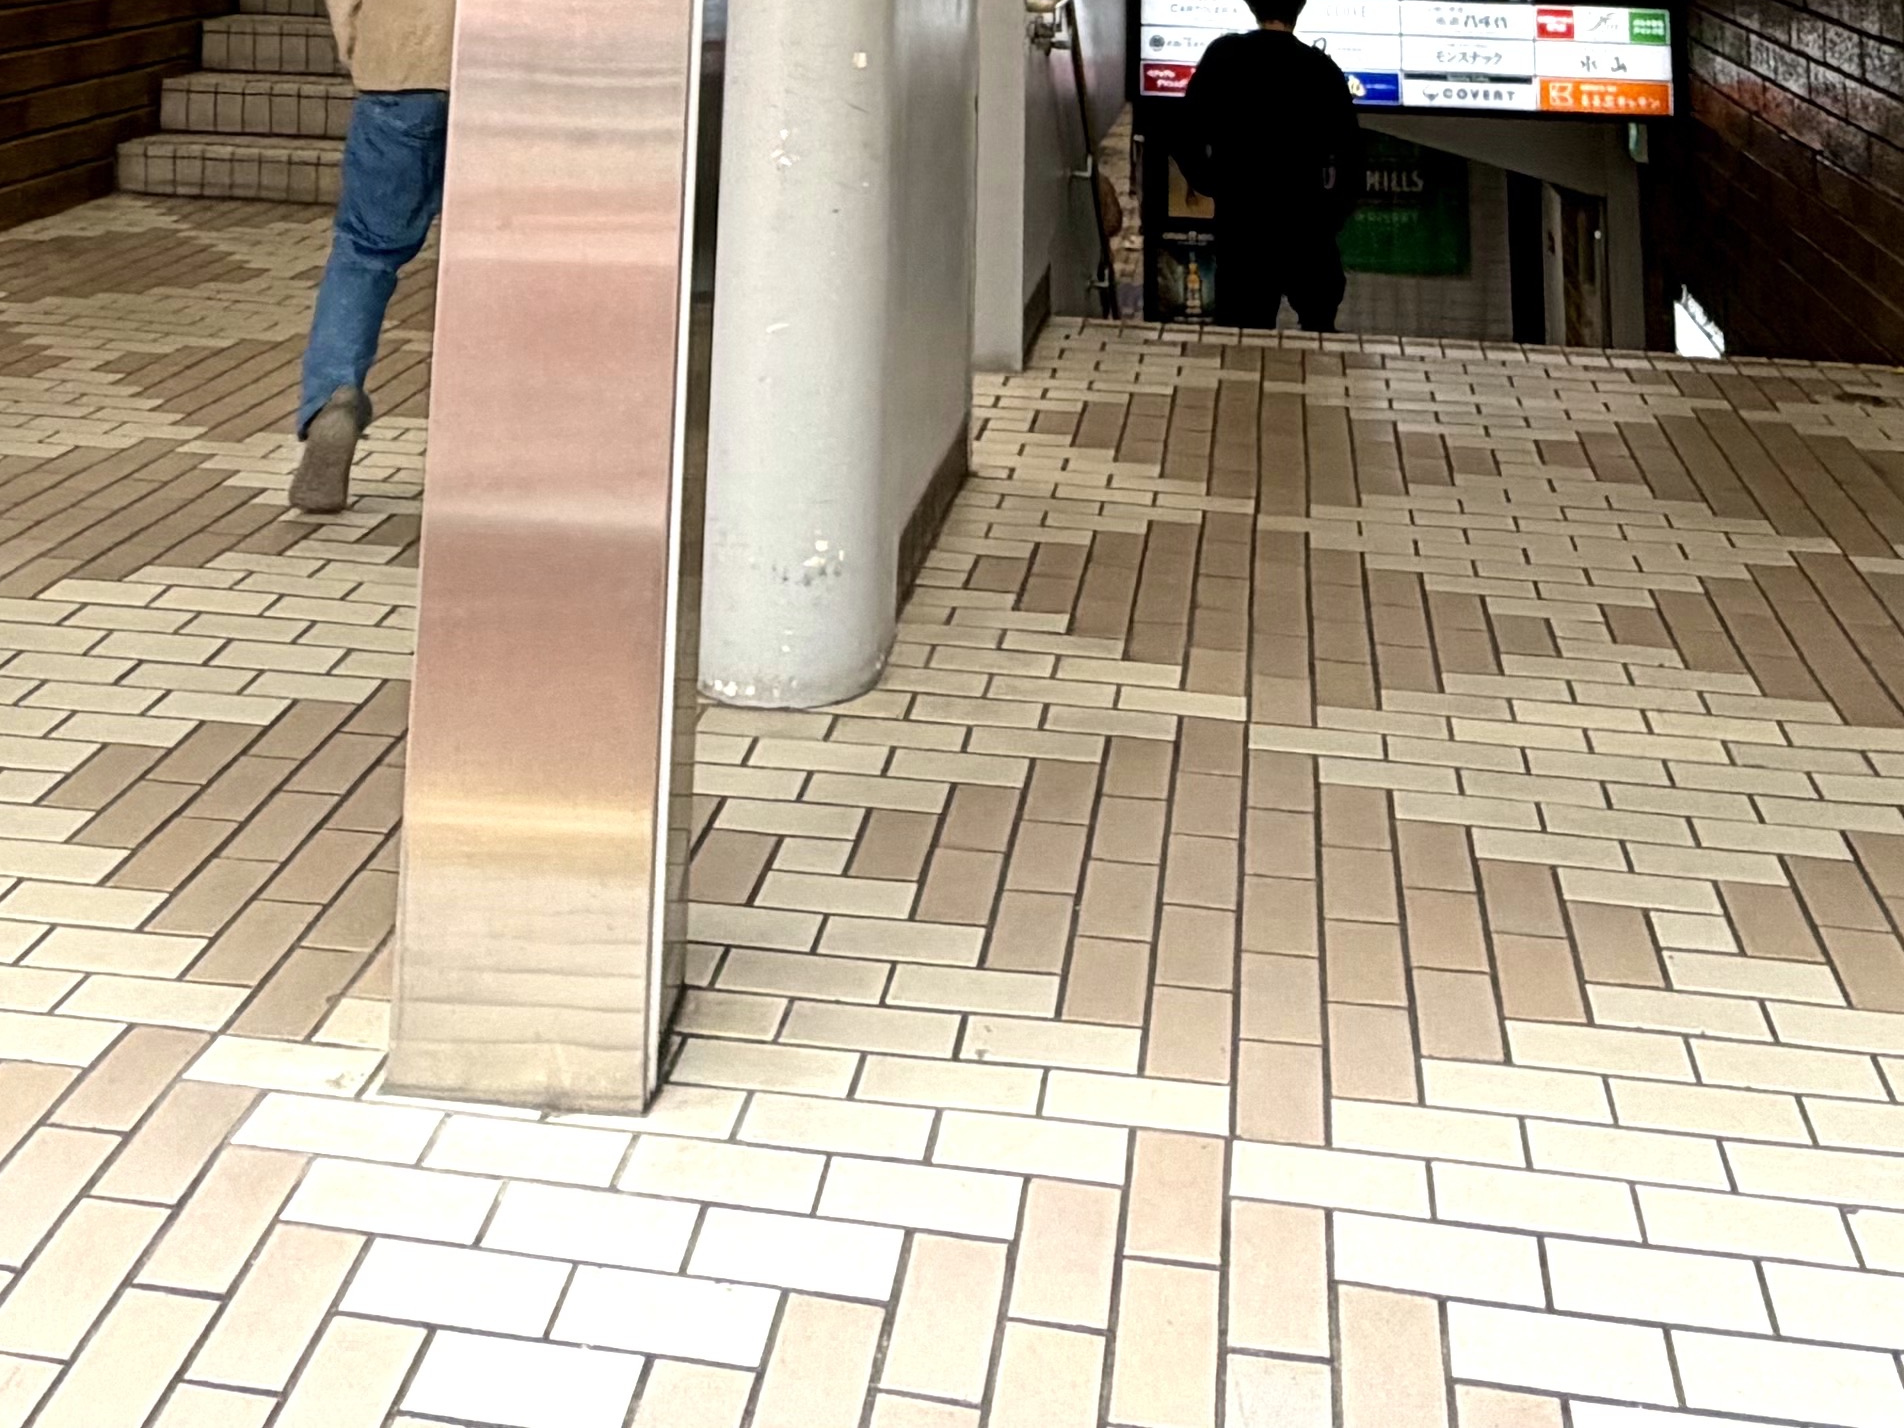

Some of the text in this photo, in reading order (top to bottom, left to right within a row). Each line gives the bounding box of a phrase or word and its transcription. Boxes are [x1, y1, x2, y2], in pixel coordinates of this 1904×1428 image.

[1436, 50, 1504, 66] モンスナック
[1442, 87, 1516, 102] COVERT
